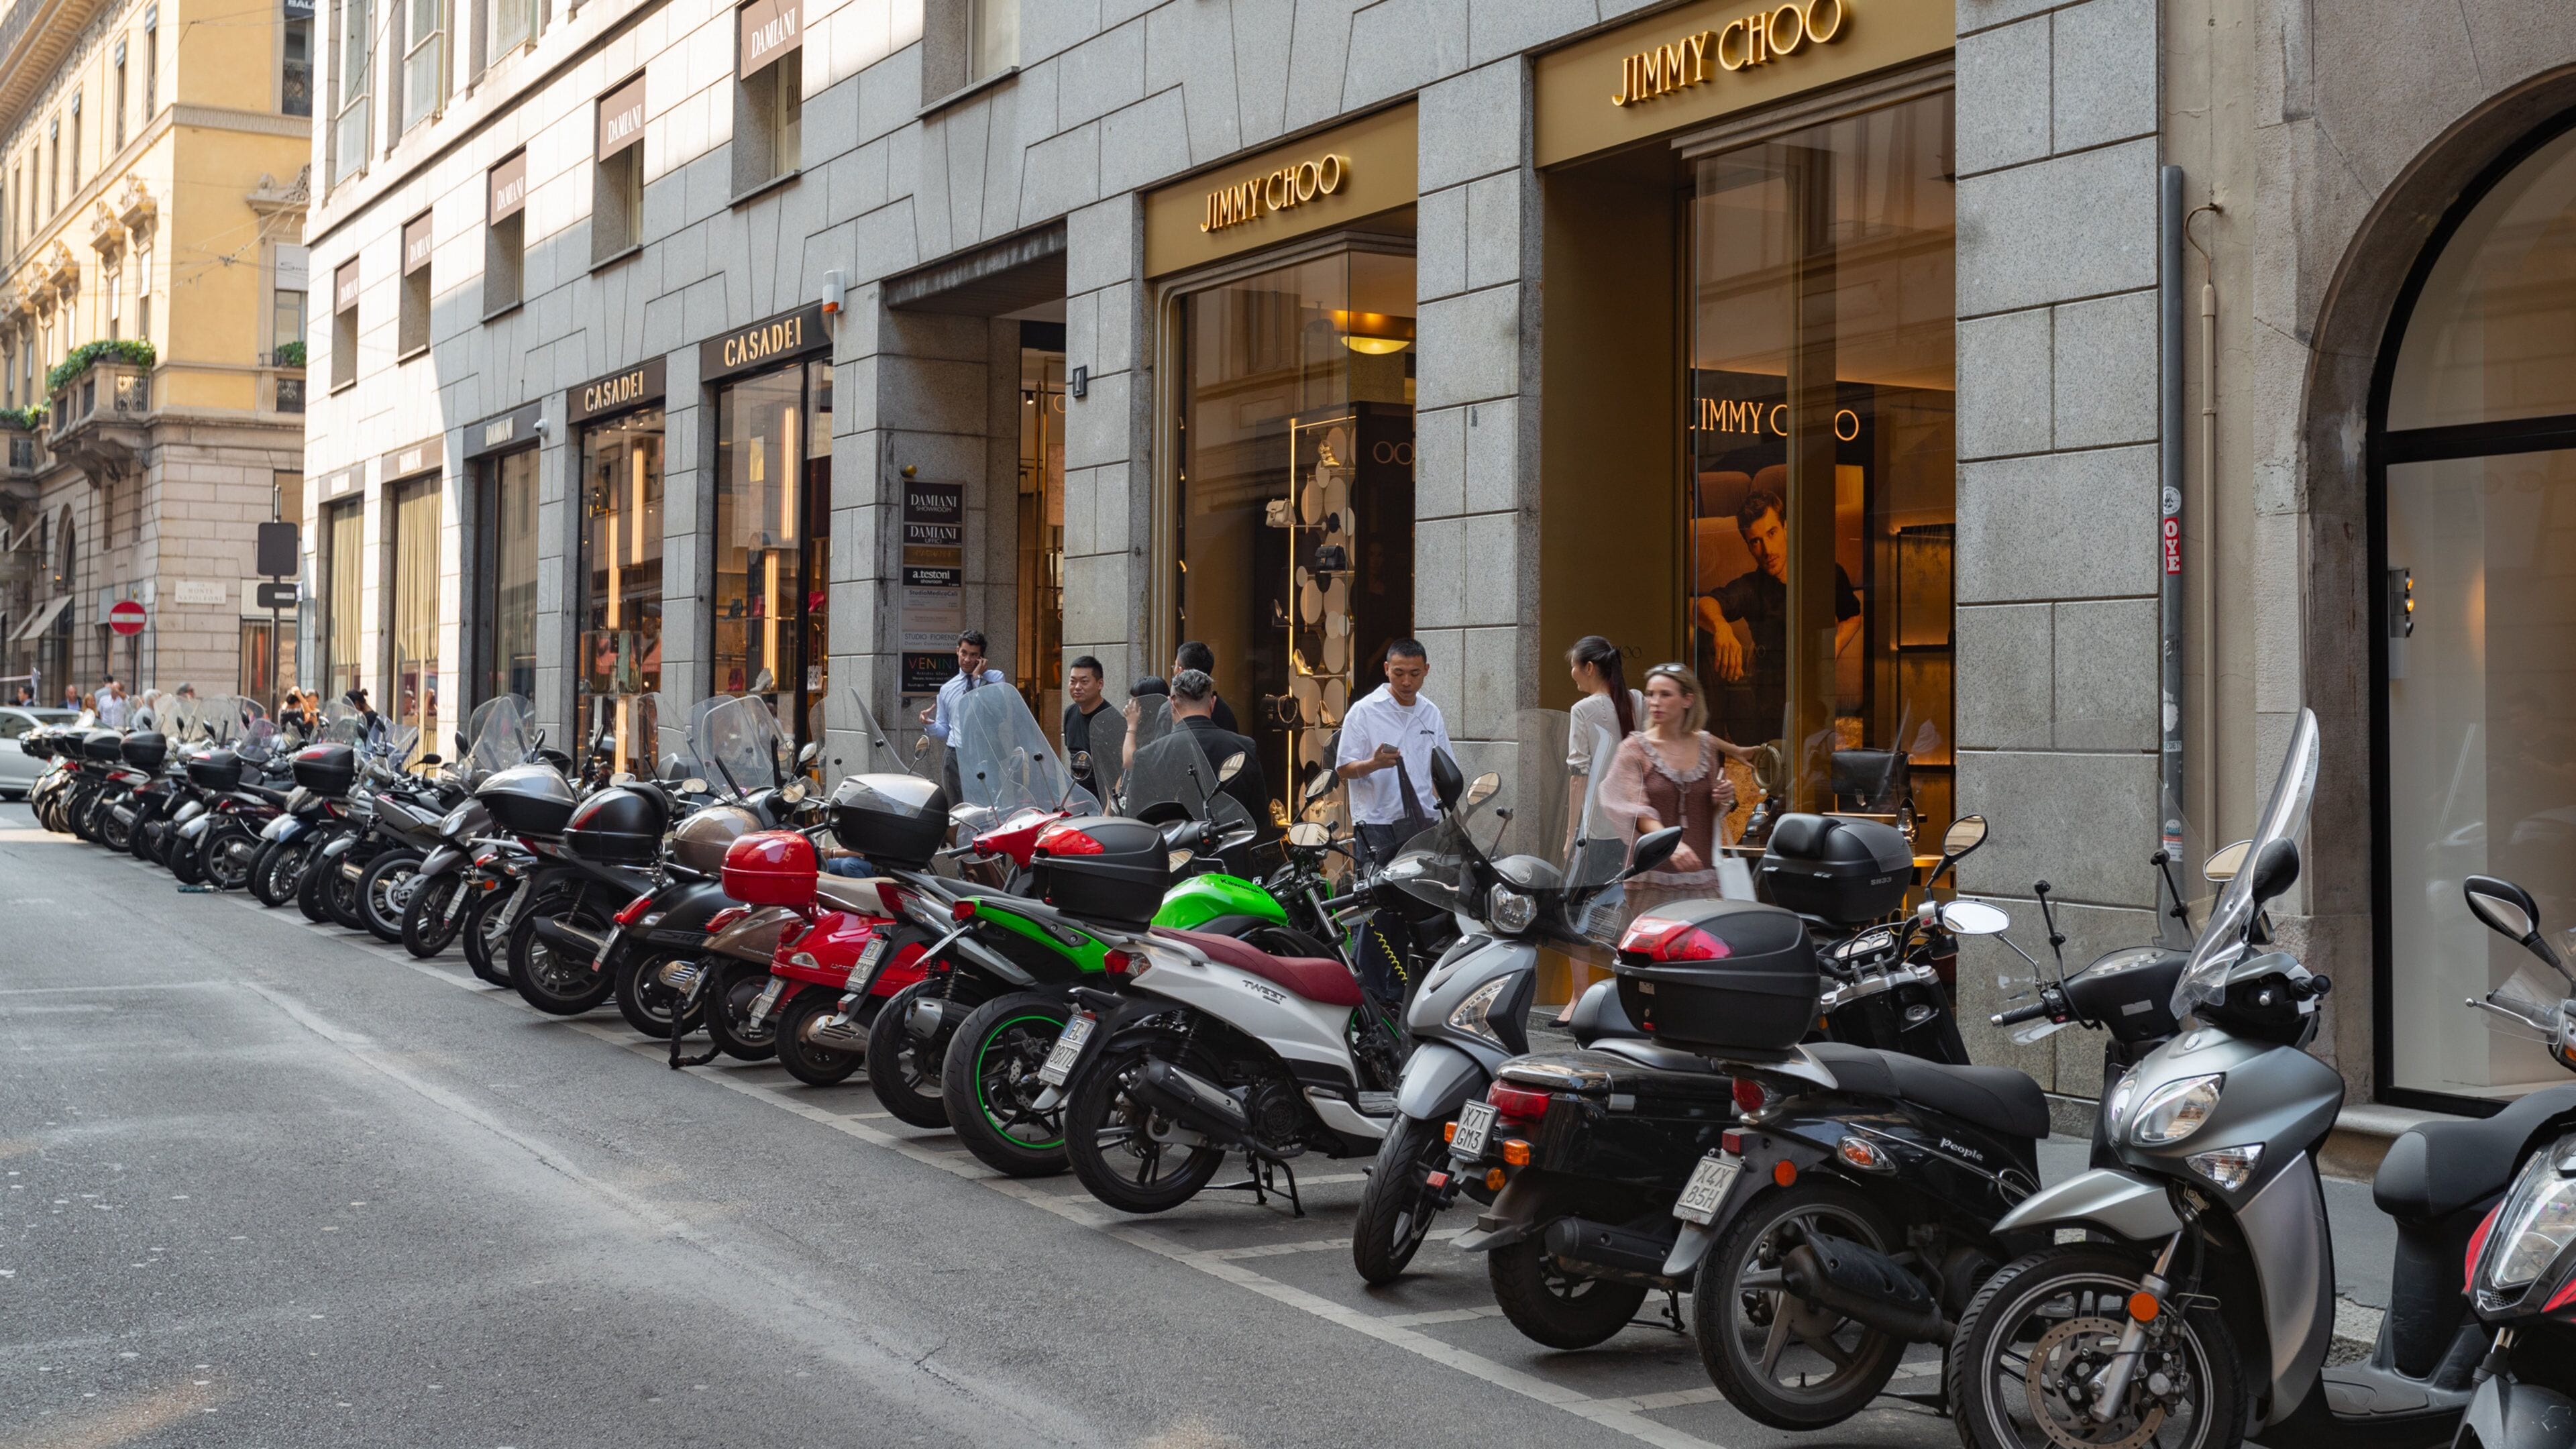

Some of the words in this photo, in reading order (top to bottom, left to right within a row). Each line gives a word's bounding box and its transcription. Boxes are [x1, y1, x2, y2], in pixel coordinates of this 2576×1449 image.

[751, 7, 796, 60] DAMIANI
[1611, 31, 1711, 107] JIMMY
[1718, 0, 1842, 70] CHOO
[607, 104, 642, 145] DAMIANI
[496, 176, 524, 212] DAMIANI
[1200, 178, 1261, 233] JIMMY
[1265, 153, 1341, 211] CHOO
[724, 316, 801, 367] CASADEI
[584, 370, 644, 413] CASADEI
[910, 494, 957, 507] DAMIANI
[910, 526, 956, 539] DAMIANI
[2165, 521, 2180, 571] OYE
[1220, 877, 1264, 896] Kawasaki
[1067, 1022, 1085, 1040] EG
[1049, 1044, 1079, 1069] 08772
[1462, 1107, 1489, 1130] X7T
[1456, 1127, 1483, 1149] GM3
[1696, 1164, 1731, 1188] X4X
[1686, 1185, 1720, 1209] 85H
